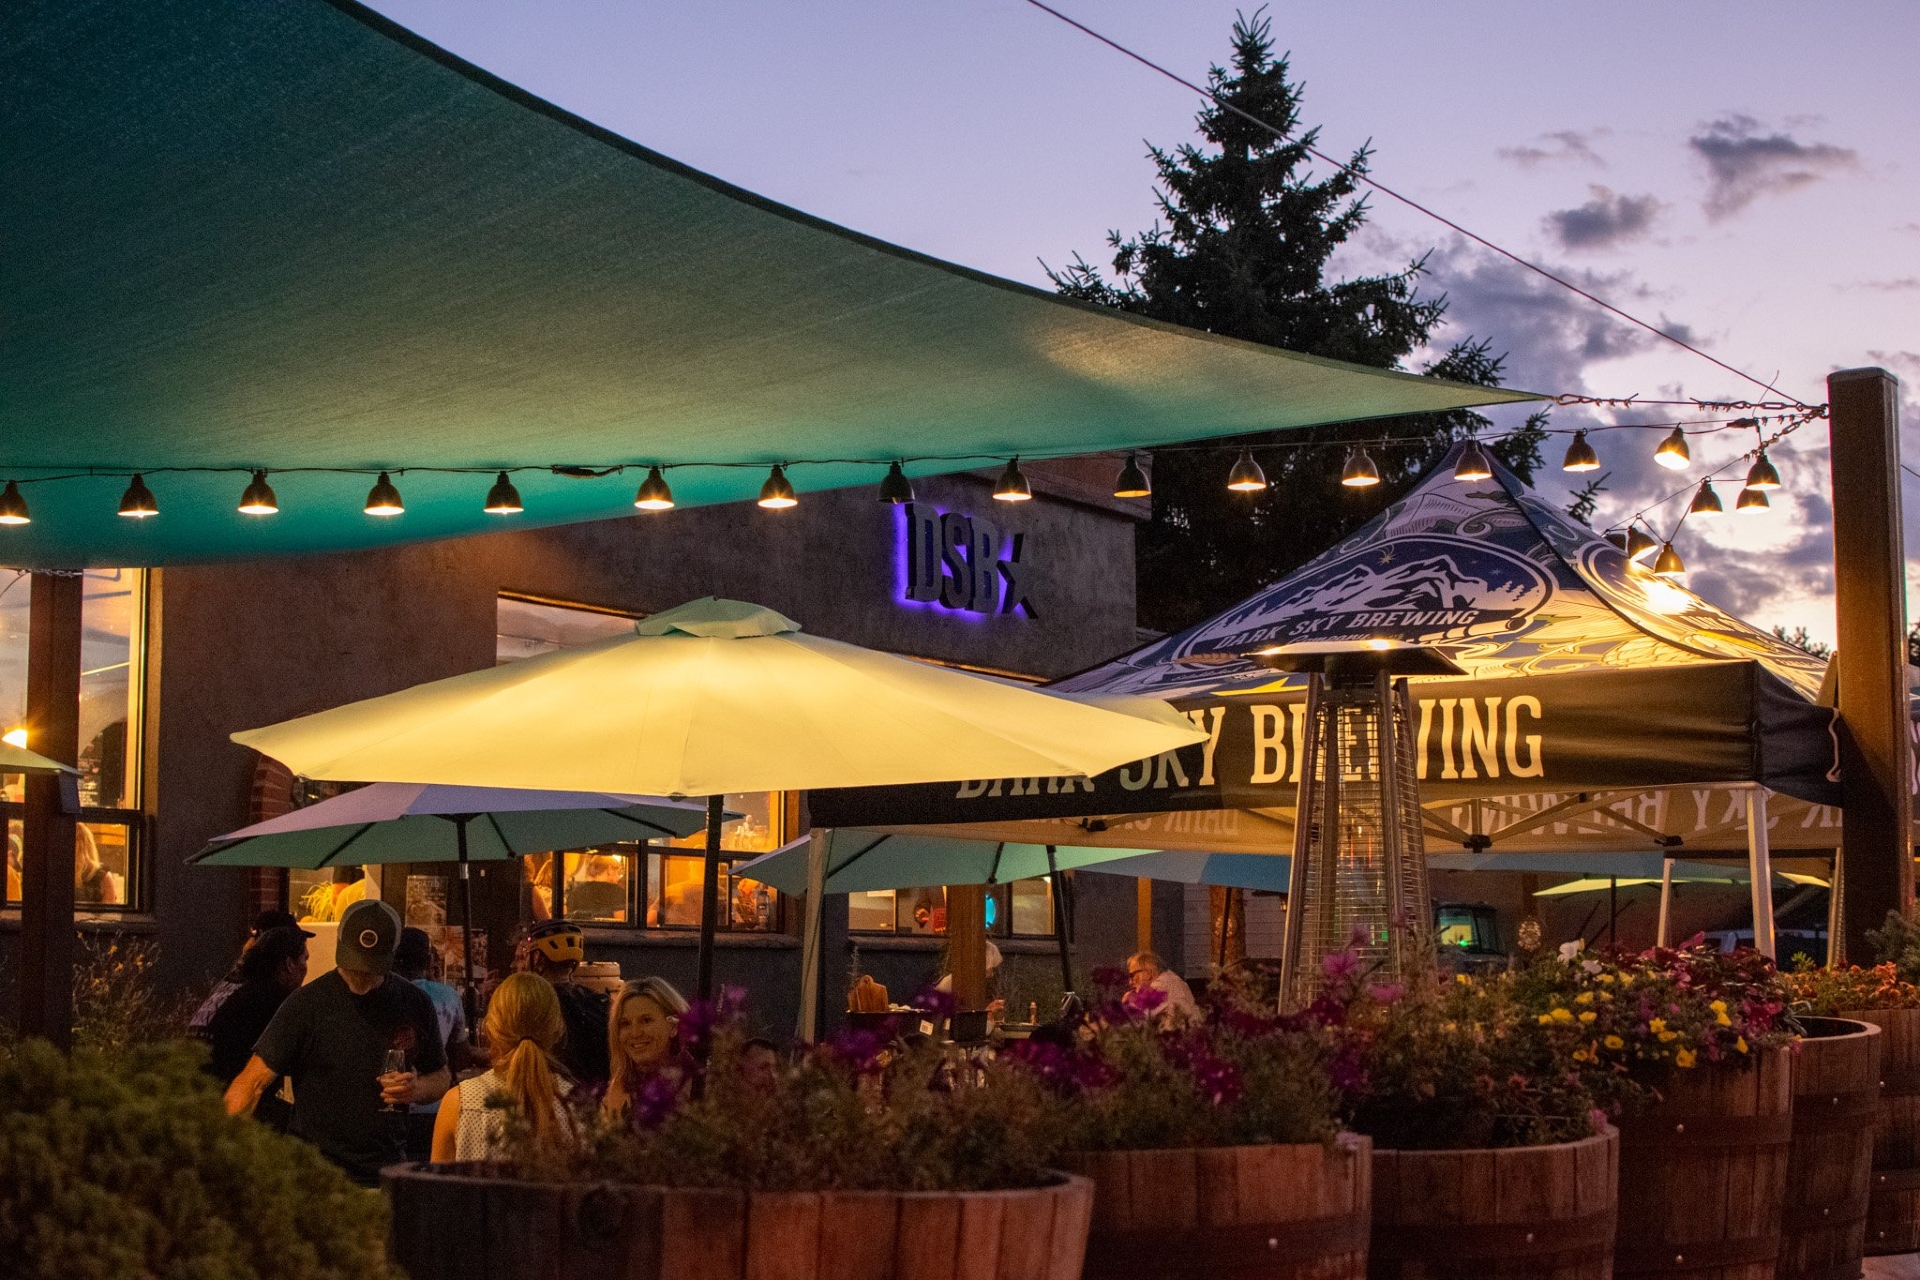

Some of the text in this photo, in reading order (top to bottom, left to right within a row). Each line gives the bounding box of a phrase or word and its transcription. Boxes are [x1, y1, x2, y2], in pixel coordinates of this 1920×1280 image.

[1212, 610, 1479, 650] DARK SKY BREWING
